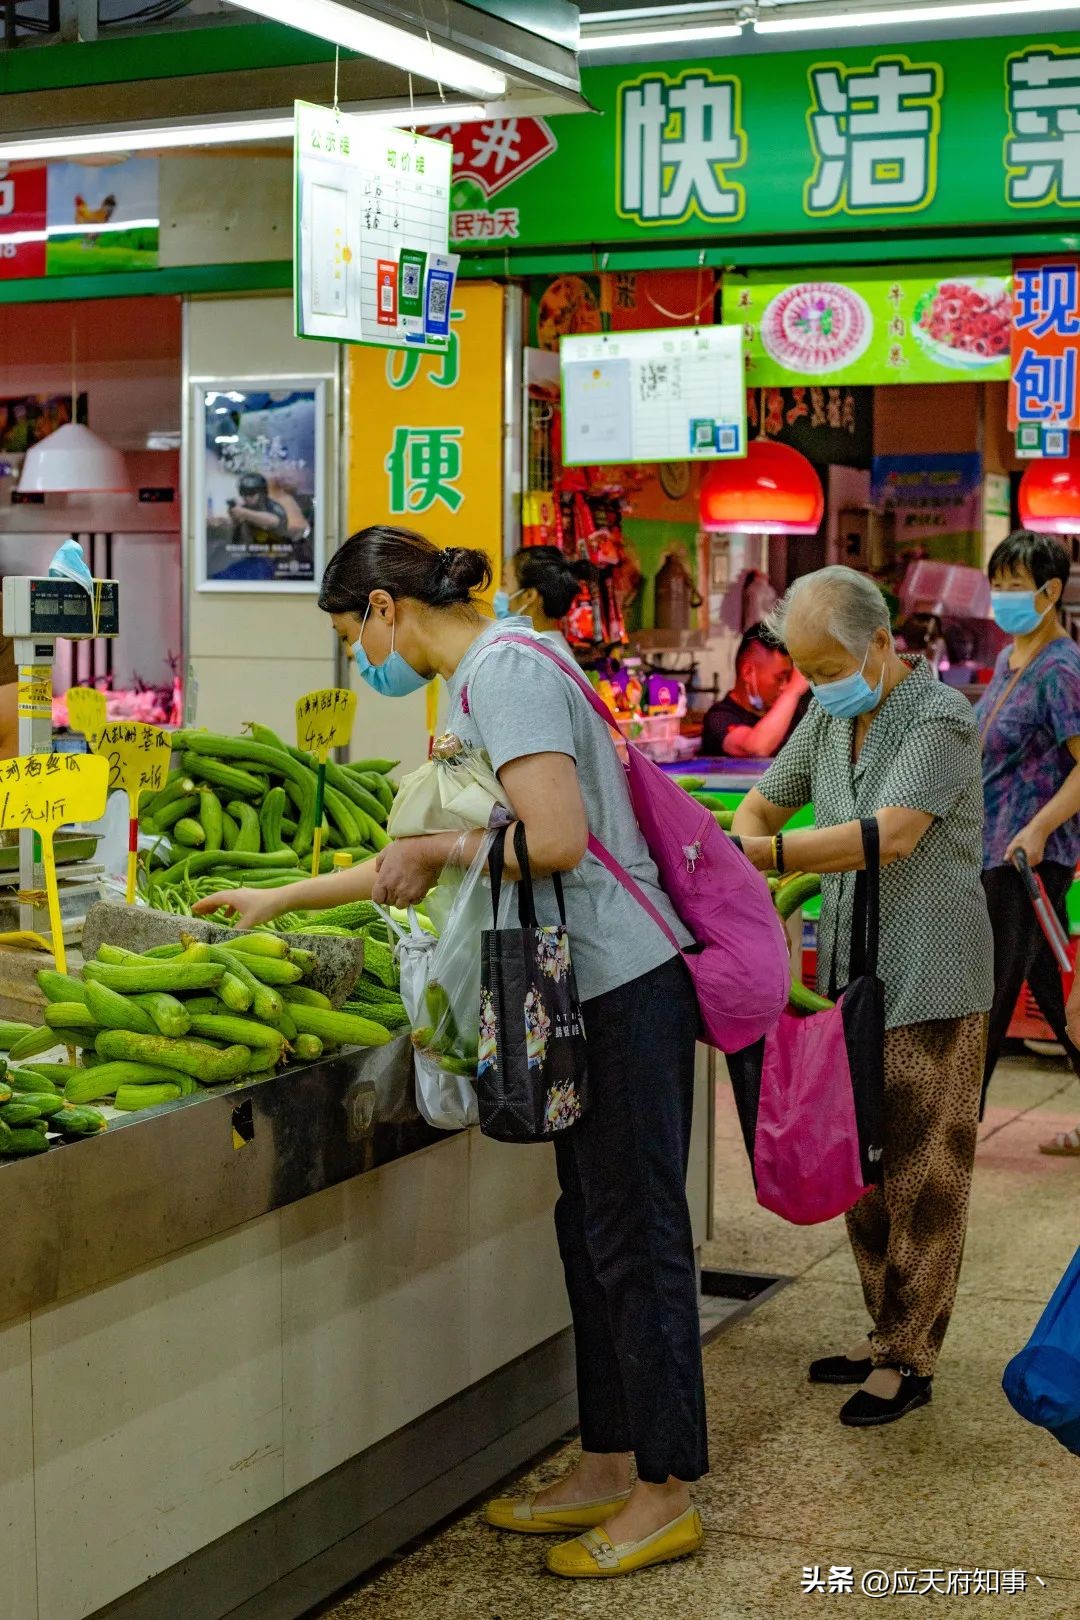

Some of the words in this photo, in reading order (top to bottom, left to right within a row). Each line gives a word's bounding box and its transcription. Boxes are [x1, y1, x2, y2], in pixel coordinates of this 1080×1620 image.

[449, 208, 519, 240] 民为天
[1013, 264, 1080, 421] 现刨
